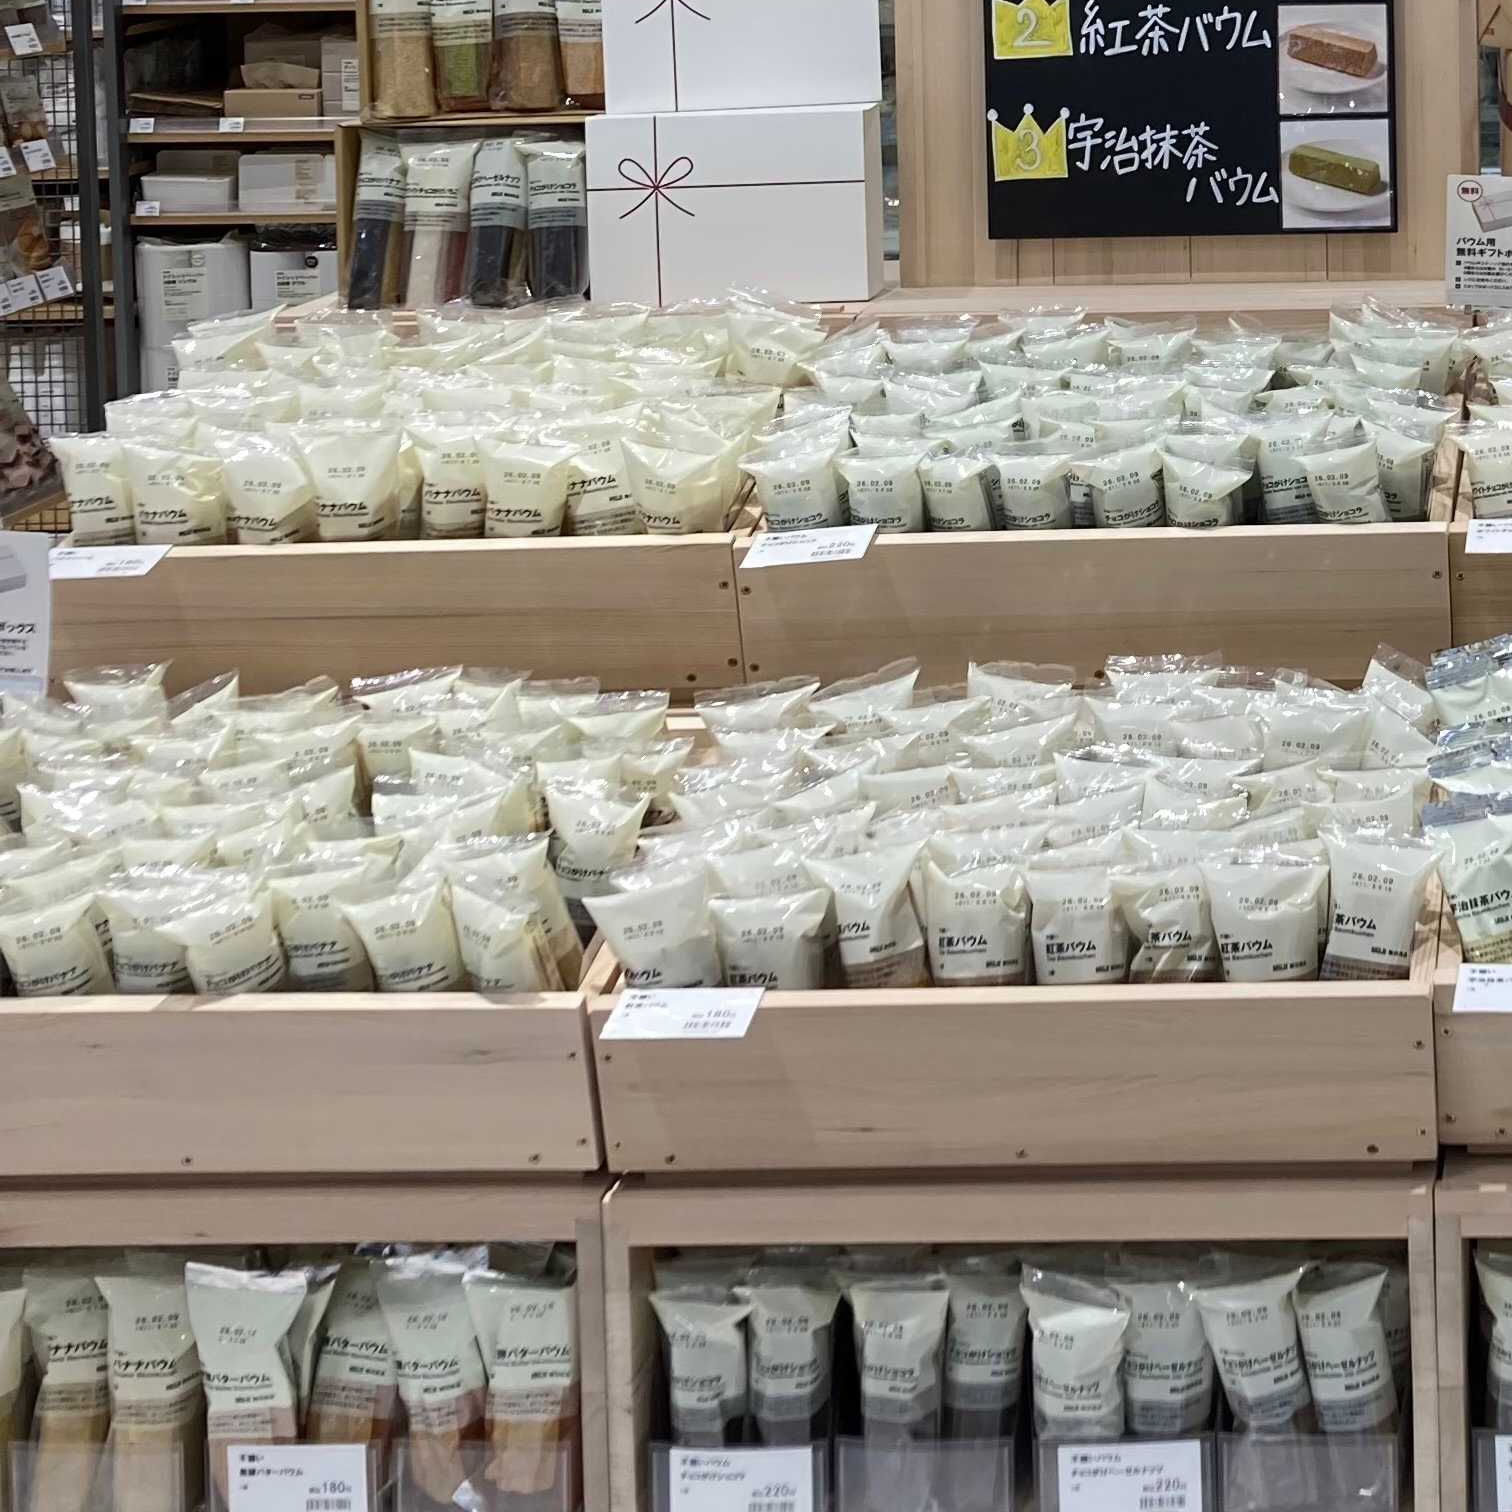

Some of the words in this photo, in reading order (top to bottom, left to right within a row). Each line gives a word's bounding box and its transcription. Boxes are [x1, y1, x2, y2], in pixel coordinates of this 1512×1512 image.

[1013, 8, 1053, 48] 2
[1015, 127, 1042, 172] 3
[1067, 112, 1219, 176] 宇治抹茶
[1185, 165, 1279, 207] バウム
[1461, 187, 1479, 195] 無料
[1456, 237, 1496, 247] バウム用
[1046, 941, 1097, 955] 紅茶バウム
